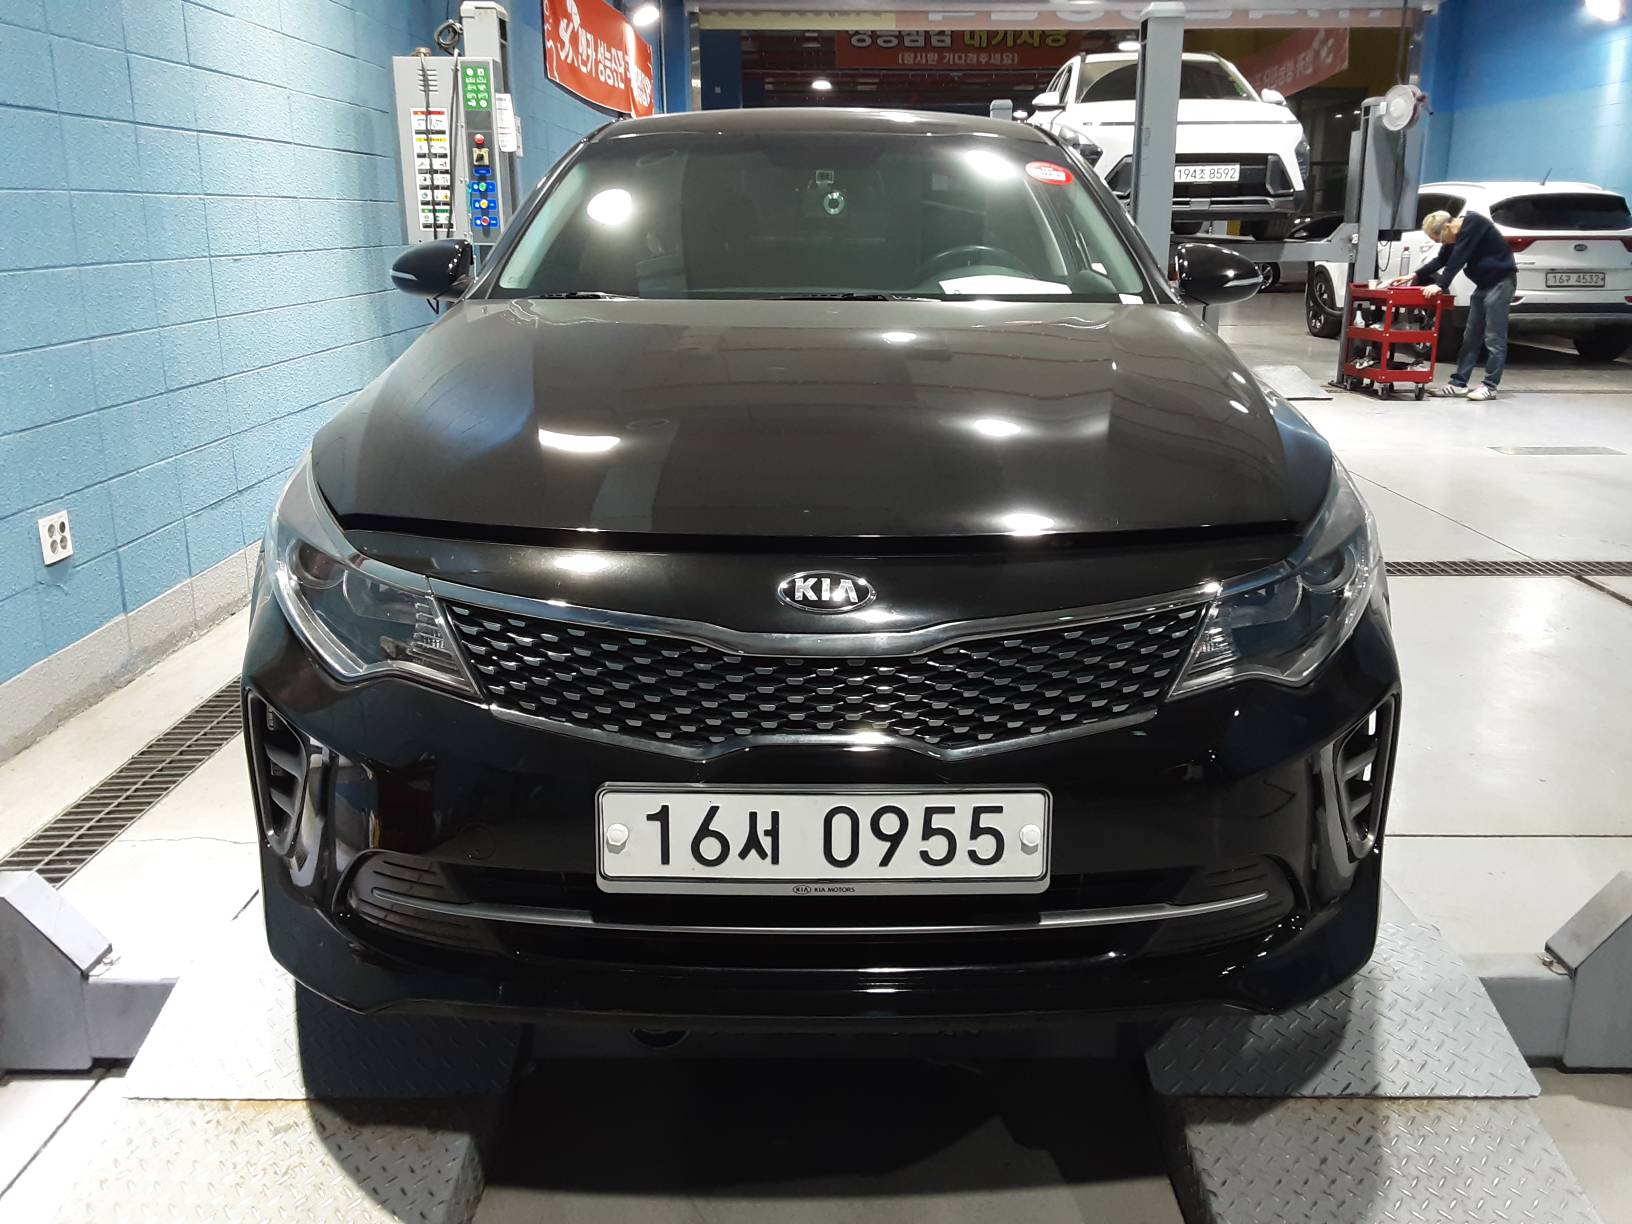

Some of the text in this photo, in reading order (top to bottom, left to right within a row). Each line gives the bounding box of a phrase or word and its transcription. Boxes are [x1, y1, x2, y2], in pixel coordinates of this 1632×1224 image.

[1208, 167, 1237, 180] 8592
[794, 578, 859, 603] KIA
[646, 804, 1005, 868] 16서 0955
